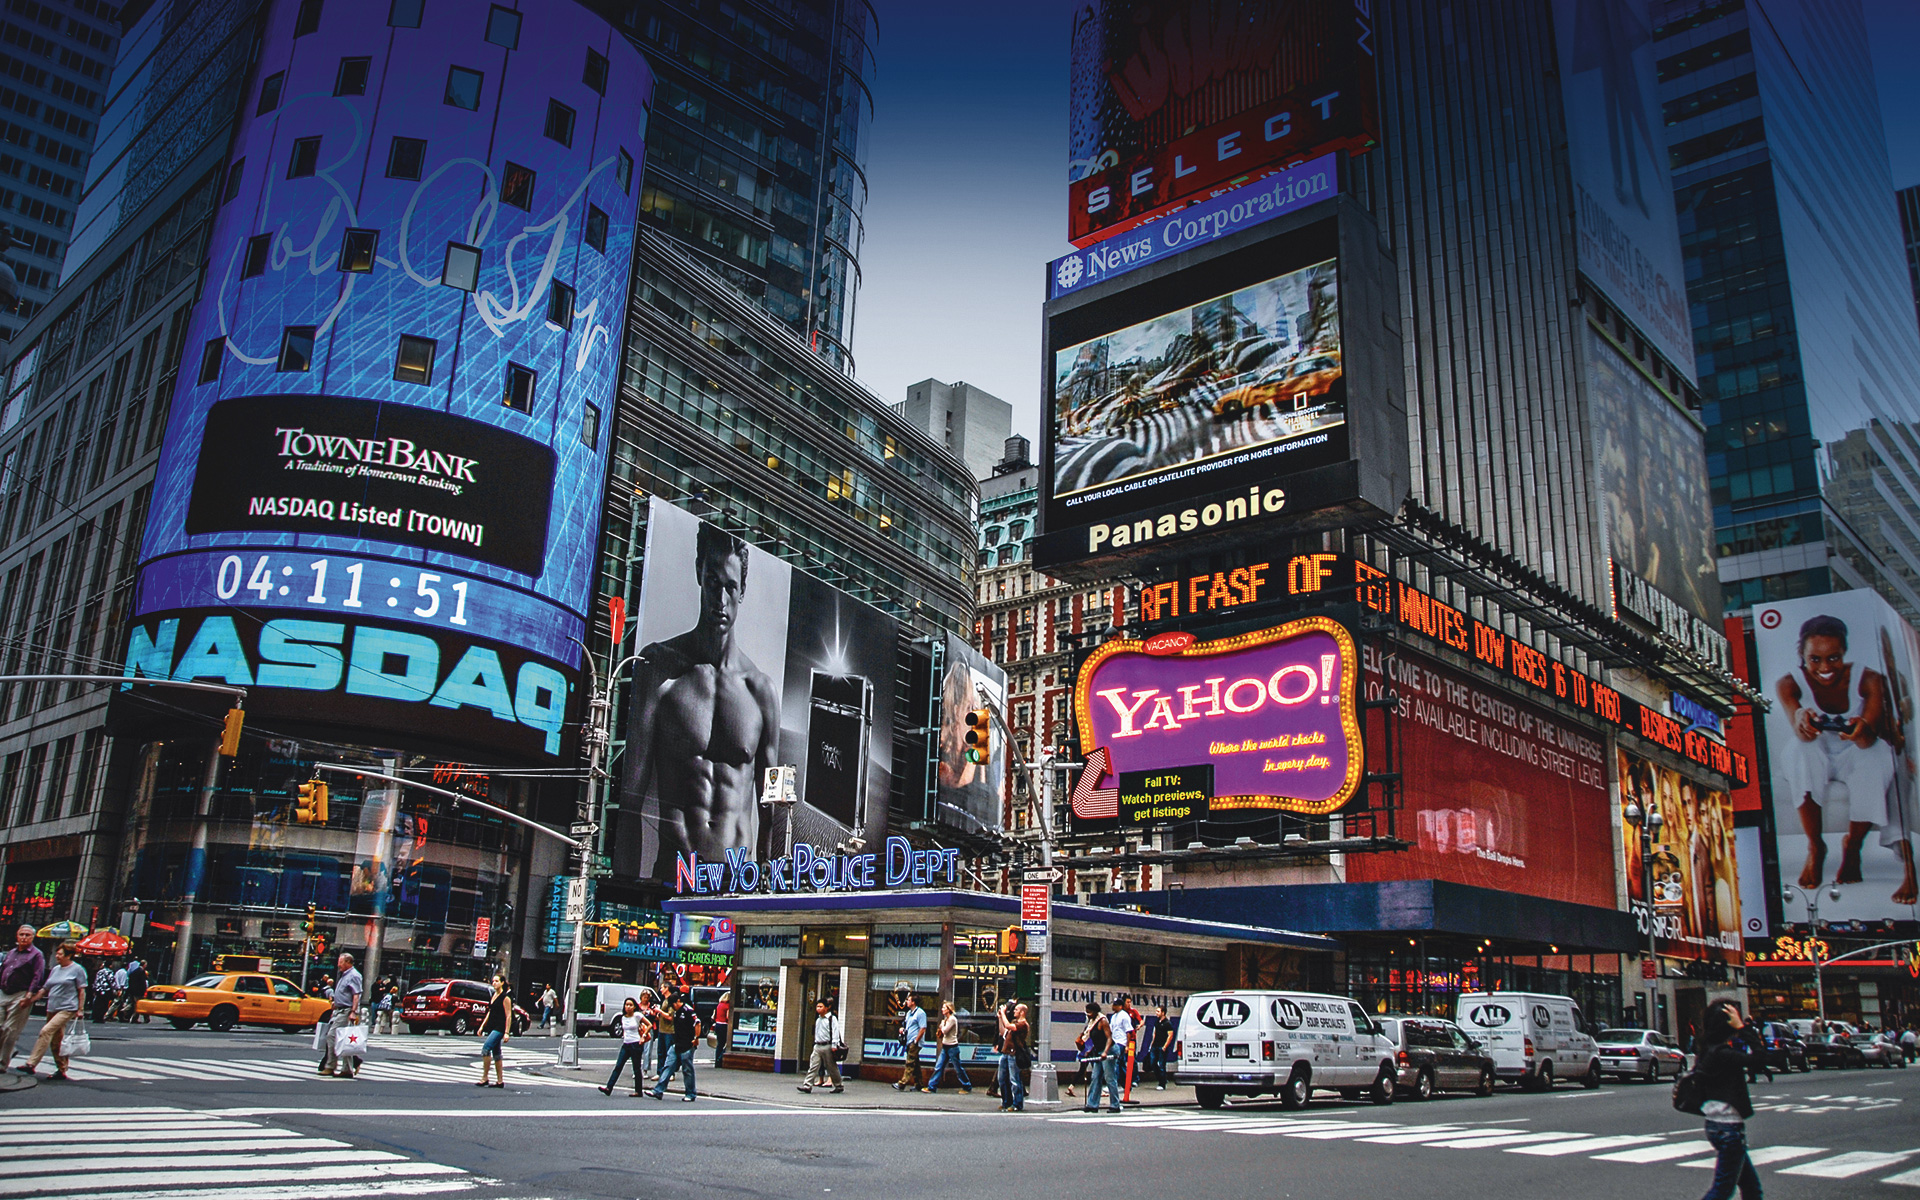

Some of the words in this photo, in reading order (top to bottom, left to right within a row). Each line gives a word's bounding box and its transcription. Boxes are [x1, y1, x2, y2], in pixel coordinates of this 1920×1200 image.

[1088, 91, 1339, 214] SELECT
[1087, 236, 1152, 278] News
[1162, 169, 1329, 248] Corporation
[285, 459, 294, 470] A
[296, 459, 343, 474] Tradition
[344, 463, 358, 478] of
[358, 465, 417, 484] Hometown
[1066, 496, 1084, 507] CALL
[1083, 490, 1102, 503] YOUR
[1102, 486, 1124, 498] LOCAL
[1124, 479, 1147, 493] CABLE
[1147, 476, 1158, 486] OR
[1158, 467, 1196, 484] SATELLITE
[1196, 458, 1233, 475] PROVIDER
[1233, 453, 1250, 466] FOR
[1250, 448, 1273, 461] MORE
[1273, 433, 1328, 456] INFORMATION
[249, 496, 336, 521] NASDAQ
[339, 502, 402, 527] Listed
[407, 509, 484, 546] [TOWN]
[1088, 485, 1286, 553] Panasonic
[1287, 553, 1337, 597] OF
[216, 554, 469, 626] 04:11:51
[1146, 634, 1189, 652] VACANCY
[120, 615, 567, 756] NASDAQ
[1096, 654, 1336, 739] YAHOO!
[1363, 644, 1421, 691] ELCOME
[1423, 669, 1441, 698] TO
[1444, 678, 1470, 710] THE
[1471, 690, 1518, 729] CENTER
[1519, 711, 1534, 735] OF
[1535, 717, 1556, 745] THE
[1556, 726, 1603, 764] UNIVERSE
[1474, 620, 1505, 669] DOW
[1511, 639, 1548, 689] RISES
[1552, 661, 1567, 698] 16
[1570, 669, 1588, 708] TO
[1640, 704, 1682, 753] BUSINESS
[1684, 730, 1709, 766] NEWS
[1709, 740, 1733, 777] FROM
[1733, 752, 1748, 784] THE
[1209, 741, 1240, 755] Where
[1241, 739, 1258, 752] the
[1258, 734, 1291, 750] world
[1291, 731, 1325, 746] checks
[1415, 698, 1478, 744] AVAILABLE
[1480, 723, 1539, 766] INCLUDING
[1540, 747, 1576, 780] STREET
[1577, 761, 1605, 790] LEVEL
[821, 750, 842, 771] MAN
[1144, 776, 1162, 788] Fall
[1163, 774, 1181, 787] TV:
[1121, 792, 1152, 805] Watch
[1153, 789, 1205, 805] previews,
[1133, 807, 1151, 822] get
[1152, 805, 1191, 819] listings
[676, 850, 725, 893] NEW
[793, 842, 876, 890] POLICE
[885, 835, 960, 886] DEPT
[572, 885, 582, 897] NO
[547, 874, 563, 953] MARKETSITE
[567, 905, 584, 916] TURNS
[751, 934, 790, 948] POLICE
[883, 933, 929, 947] POLICE
[1051, 988, 1097, 1003] ELCOME
[1100, 991, 1113, 1004] TO
[1300, 1001, 1328, 1014] COMMERCIAL
[1201, 999, 1243, 1023] ALL
[1275, 998, 1300, 1023] ALL
[1475, 1005, 1506, 1025] ALL
[1320, 1017, 1346, 1029] SPECIALISTS
[747, 1033, 777, 1048] NYPD
